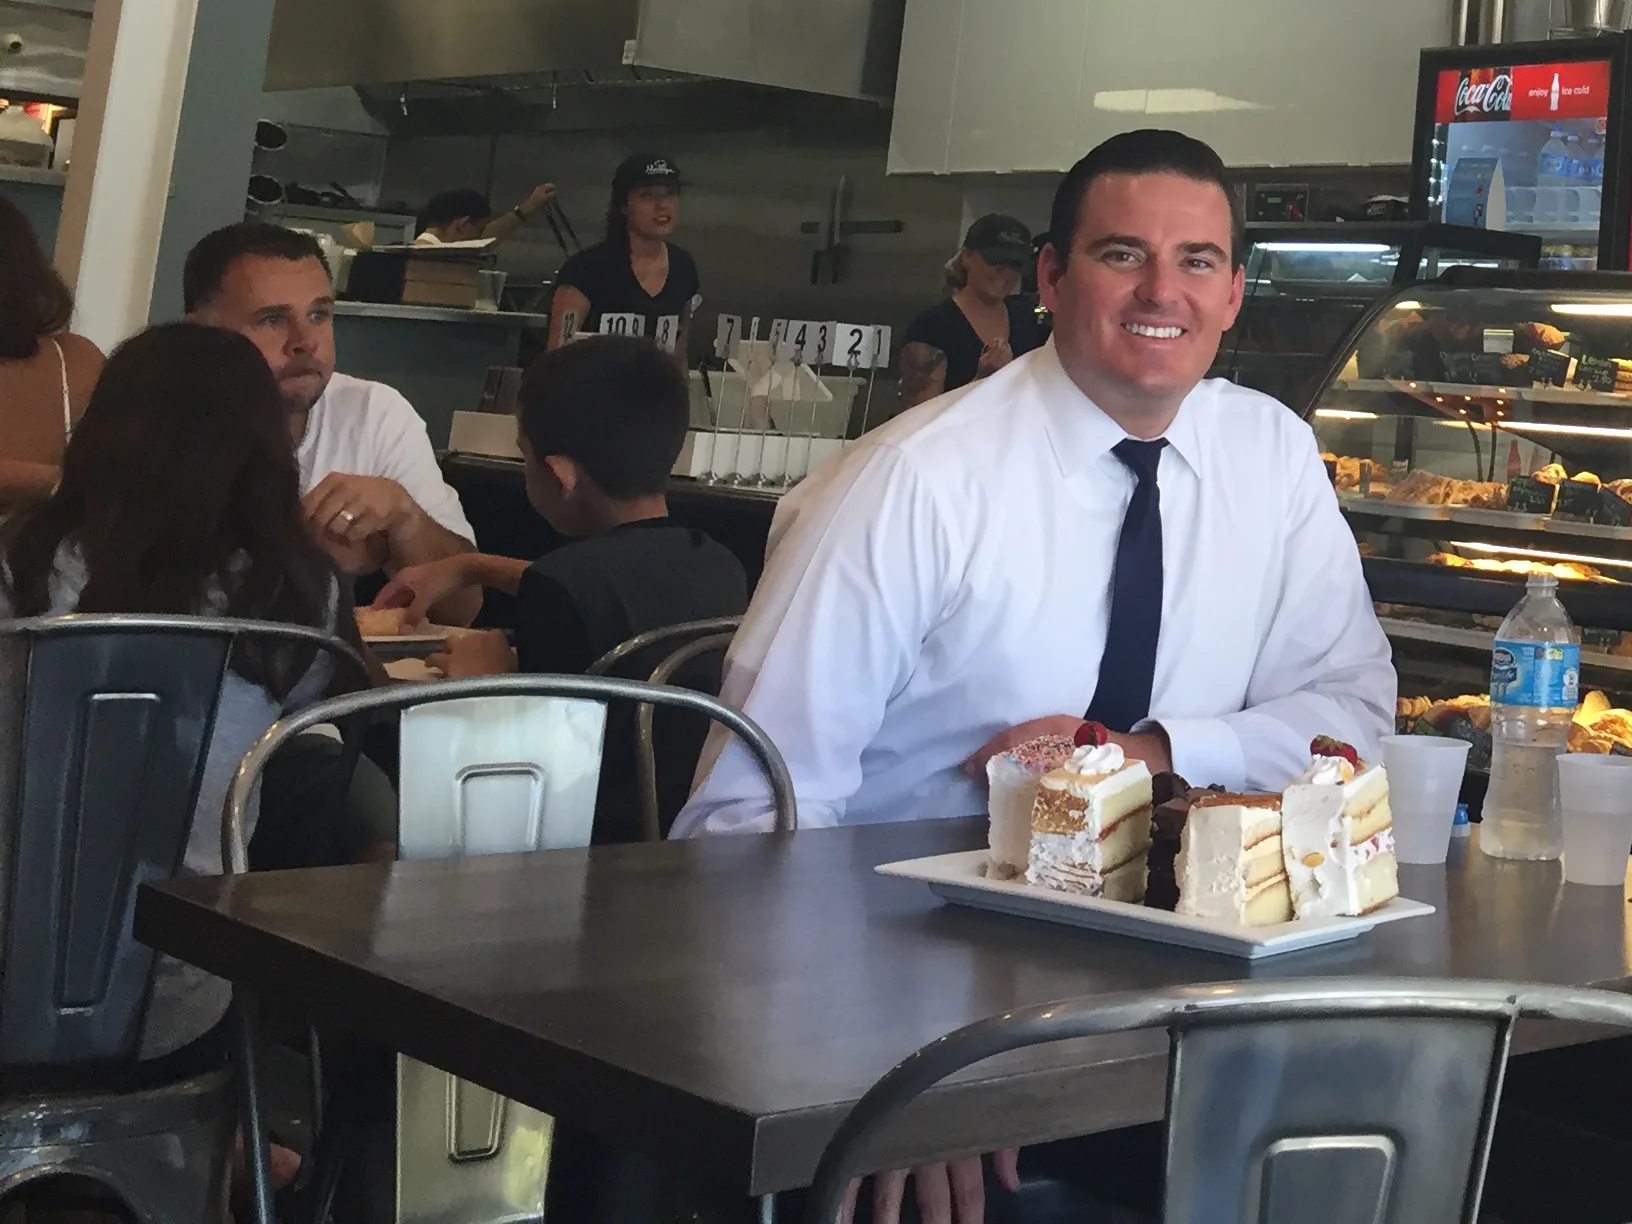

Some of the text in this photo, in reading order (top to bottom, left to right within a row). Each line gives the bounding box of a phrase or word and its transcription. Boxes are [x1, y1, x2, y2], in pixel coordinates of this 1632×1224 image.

[1454, 74, 1513, 116] Coca-Cola
[1528, 85, 1590, 98] enjoy ice cold
[661, 318, 670, 344] 8
[727, 317, 734, 344] 7
[795, 324, 807, 350] 4
[818, 325, 827, 352] 3
[847, 328, 862, 355] 2
[877, 329, 882, 355] 1
